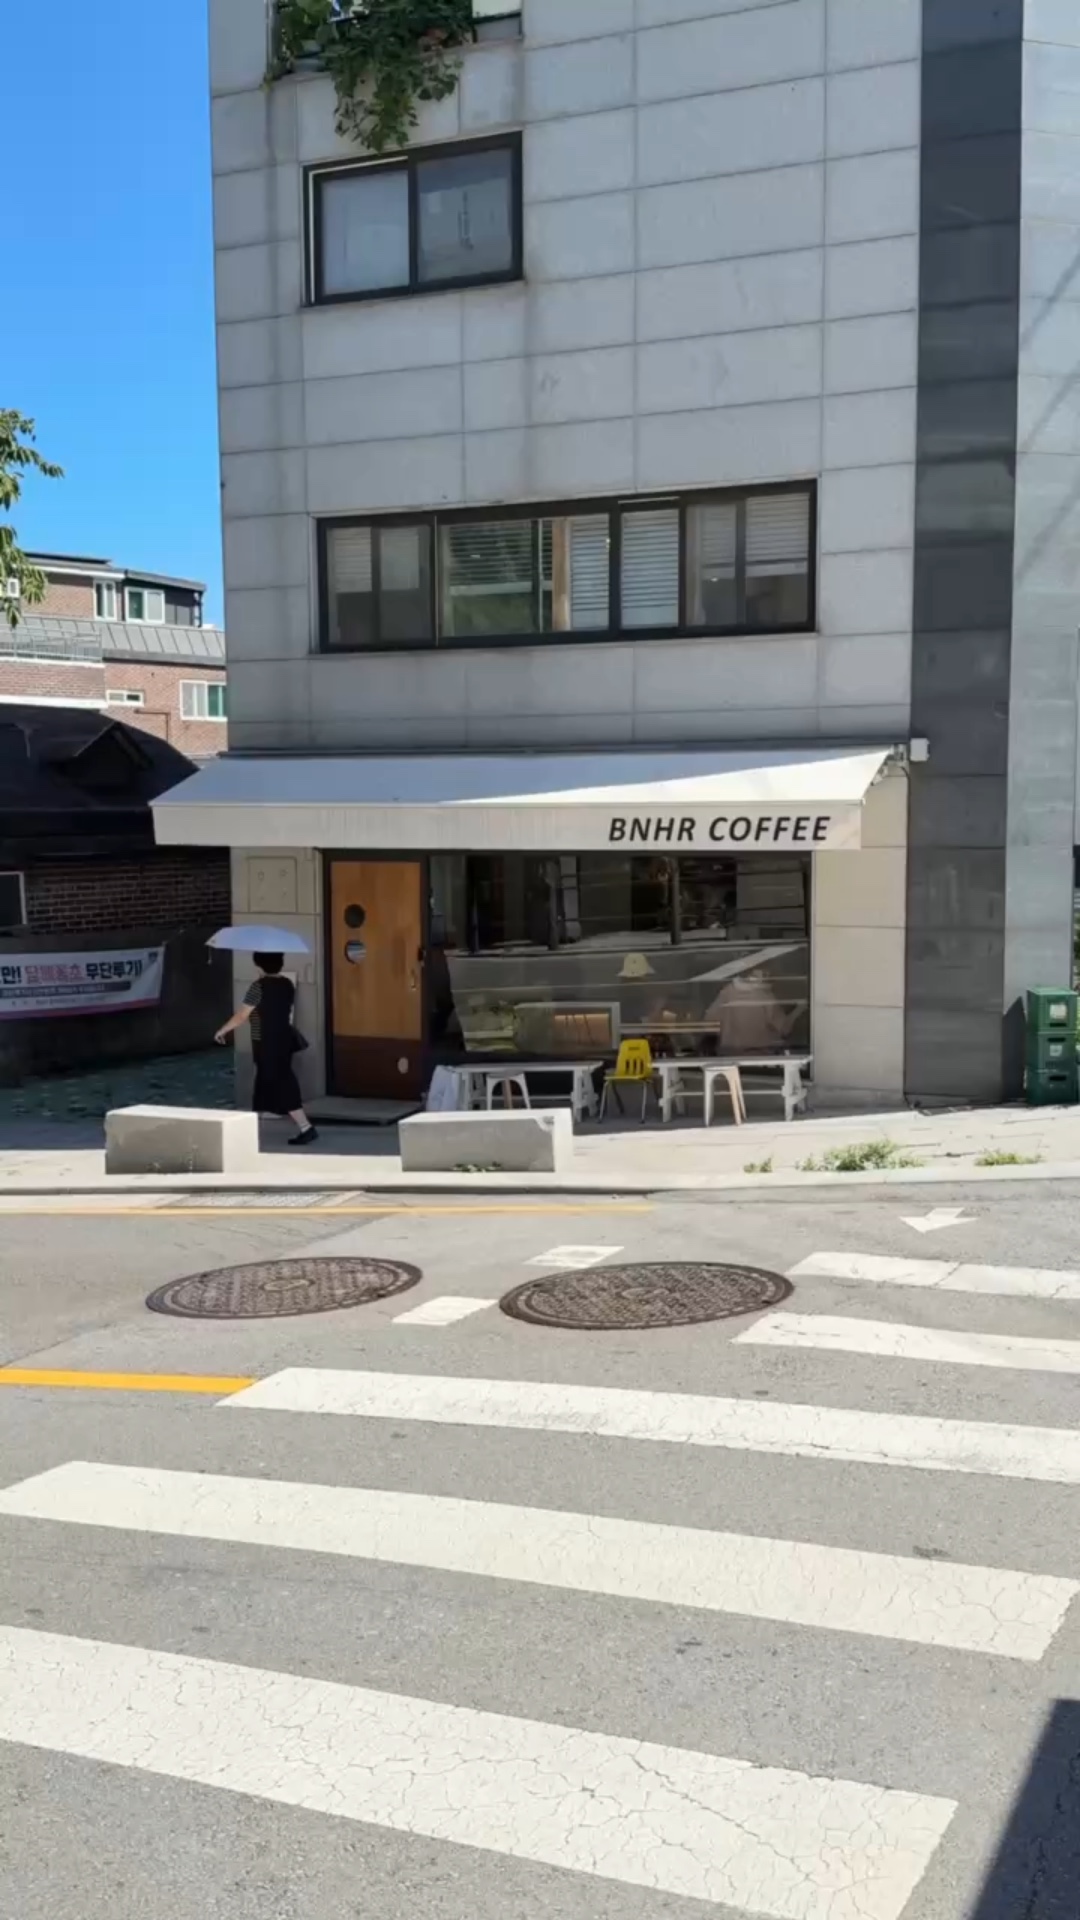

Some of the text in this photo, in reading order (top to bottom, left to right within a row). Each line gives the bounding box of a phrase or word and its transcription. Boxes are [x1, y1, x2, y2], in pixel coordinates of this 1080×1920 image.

[609, 816, 831, 842] BNHR COFFEE
[0, 966, 21, 985] 만!
